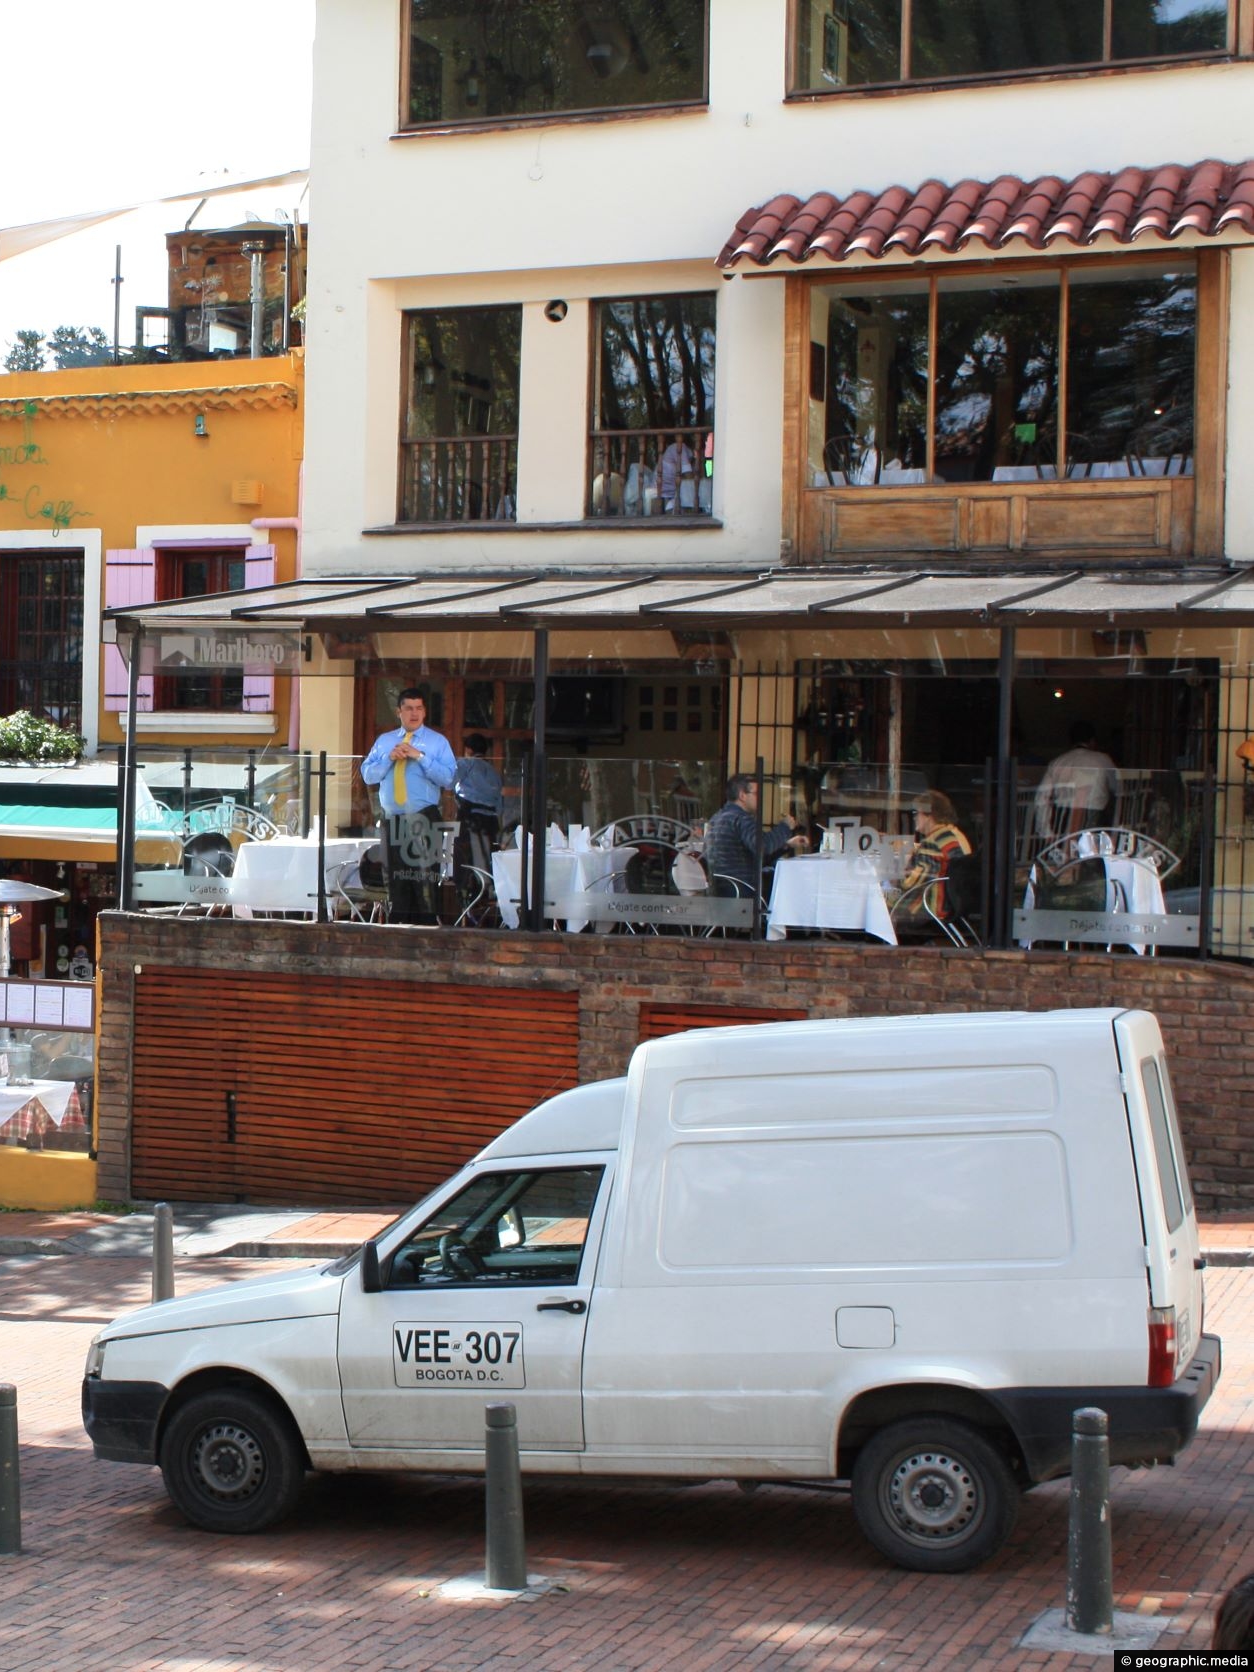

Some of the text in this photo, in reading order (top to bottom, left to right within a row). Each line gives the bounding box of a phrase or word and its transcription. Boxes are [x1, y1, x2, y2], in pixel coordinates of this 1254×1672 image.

[199, 637, 285, 664] Marlboro
[394, 1329, 520, 1364] VEE 307
[415, 1368, 504, 1381] BOGOTA D.C.
